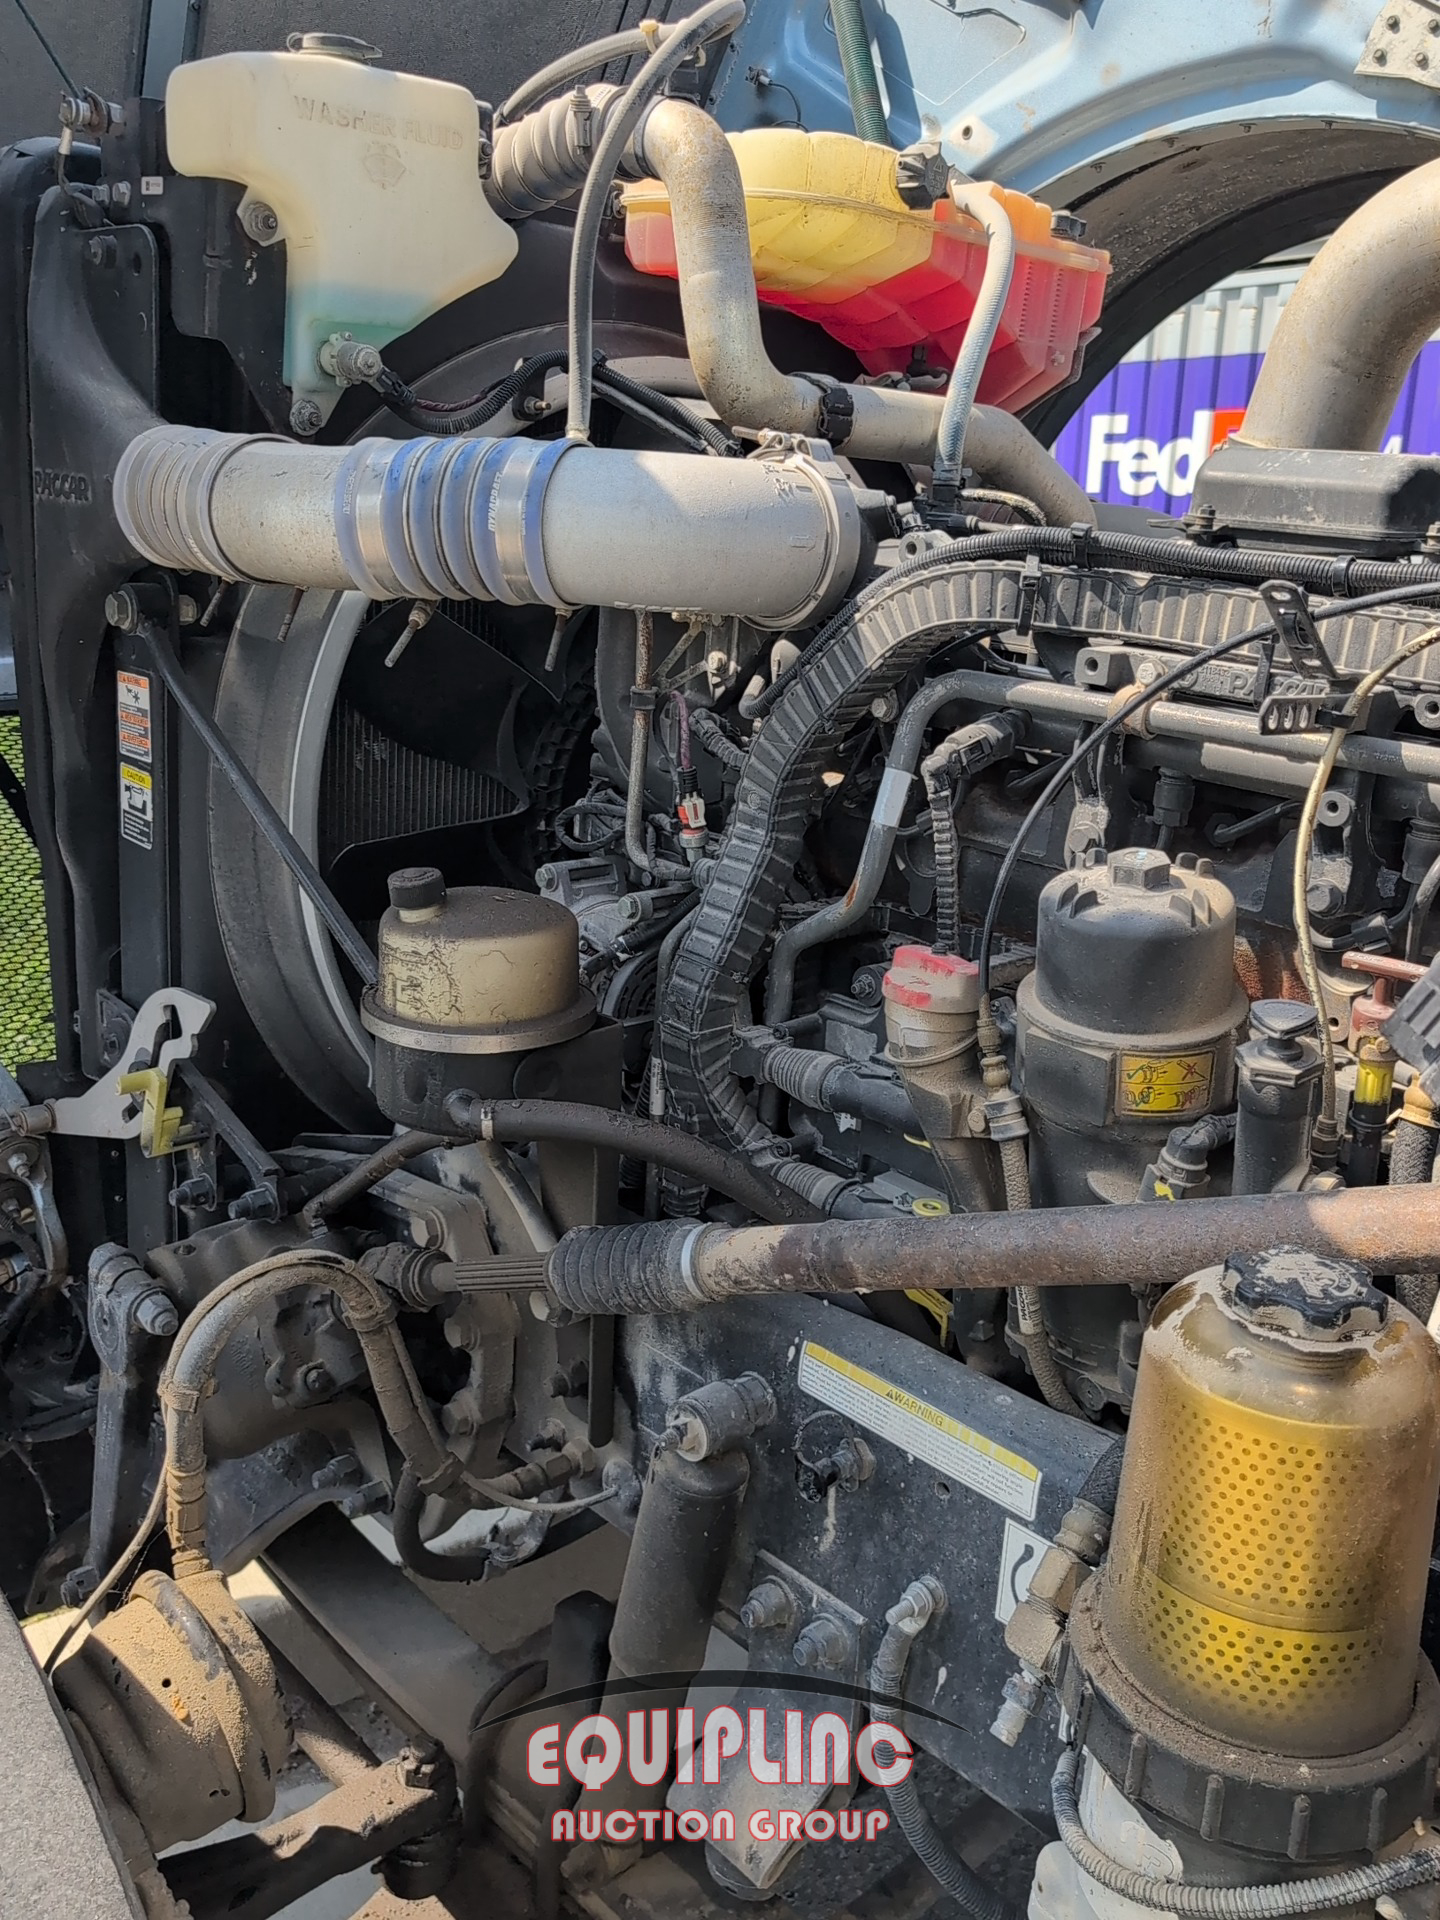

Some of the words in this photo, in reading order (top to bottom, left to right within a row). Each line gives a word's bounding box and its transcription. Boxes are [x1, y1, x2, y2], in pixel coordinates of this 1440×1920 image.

[294, 95, 396, 137] WASHER
[402, 120, 463, 150] FLUID
[34, 469, 89, 502] PACCAR
[127, 769, 146, 785] CAUTION
[893, 1390, 943, 1427] WARNING
